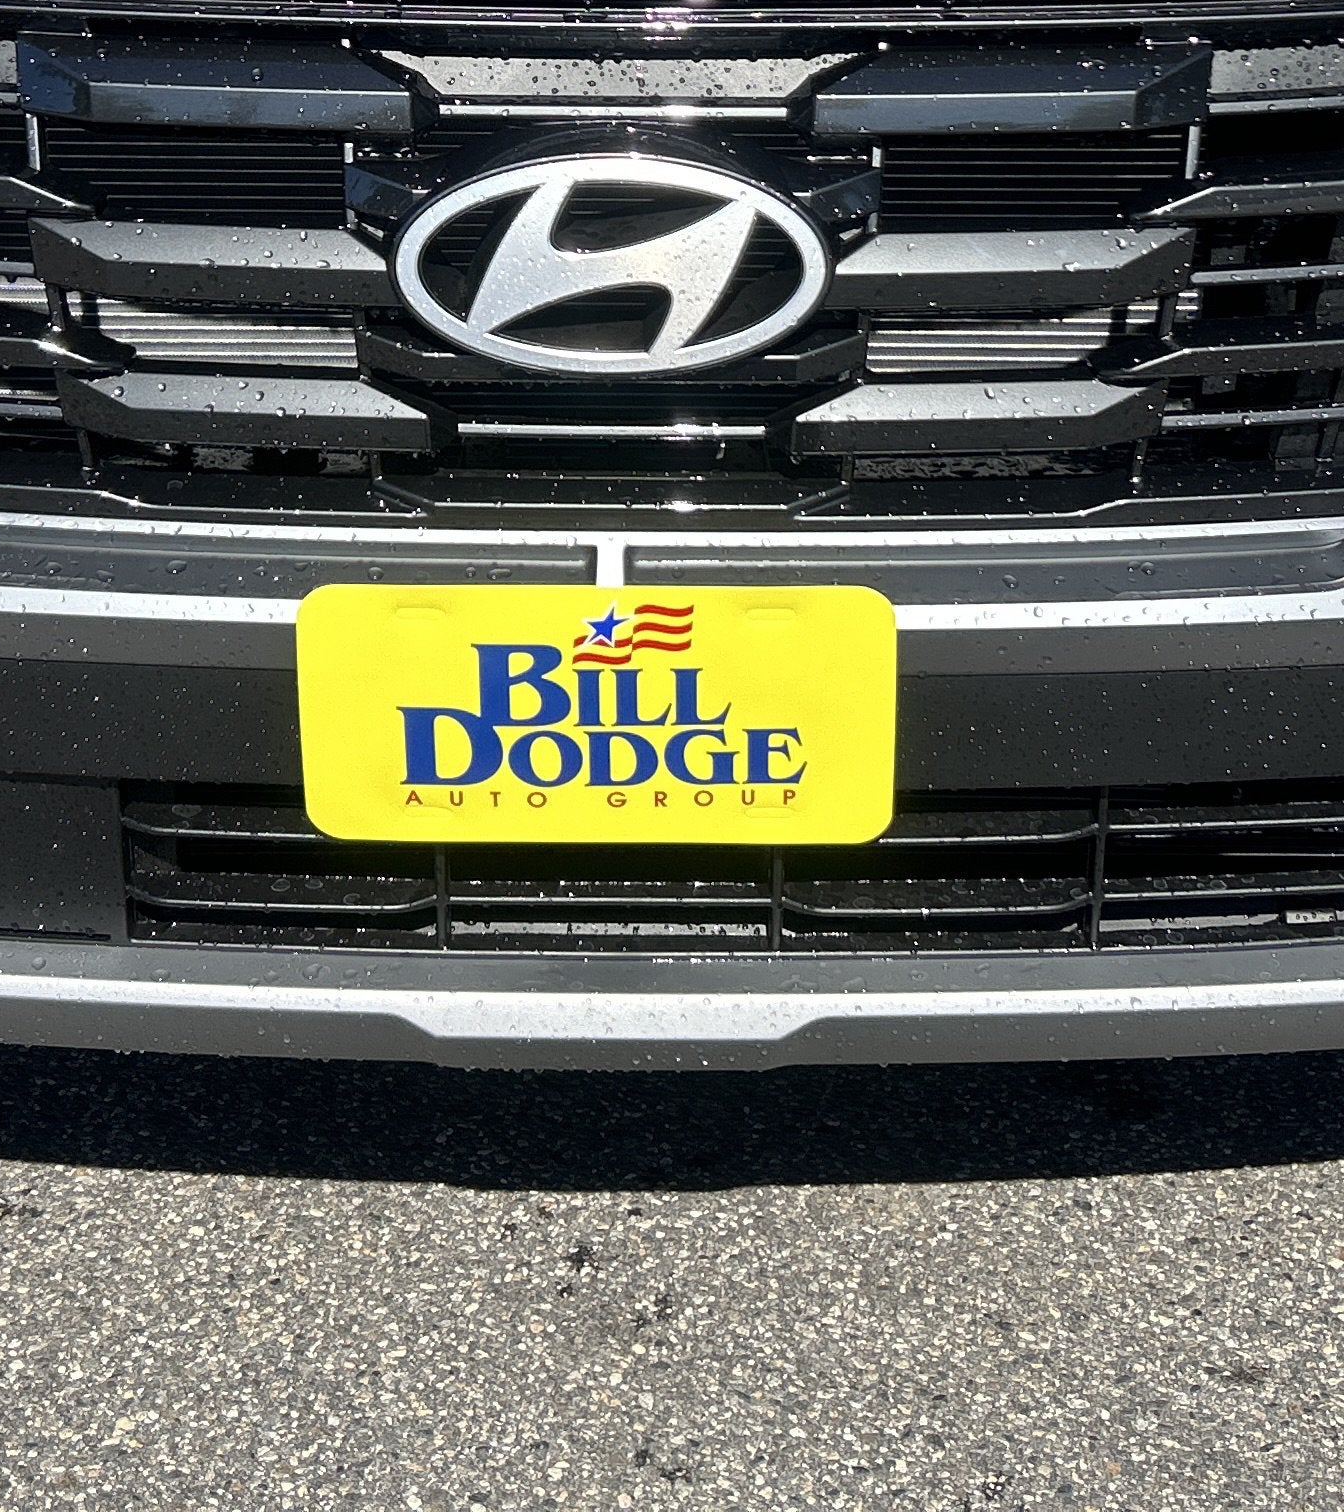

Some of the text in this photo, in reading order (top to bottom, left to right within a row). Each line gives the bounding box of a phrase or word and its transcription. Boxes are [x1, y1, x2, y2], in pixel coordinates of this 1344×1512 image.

[471, 643, 732, 727] BILL
[396, 706, 808, 787] DODGE
[405, 789, 548, 808] AUTO
[606, 789, 798, 808] GROUP
